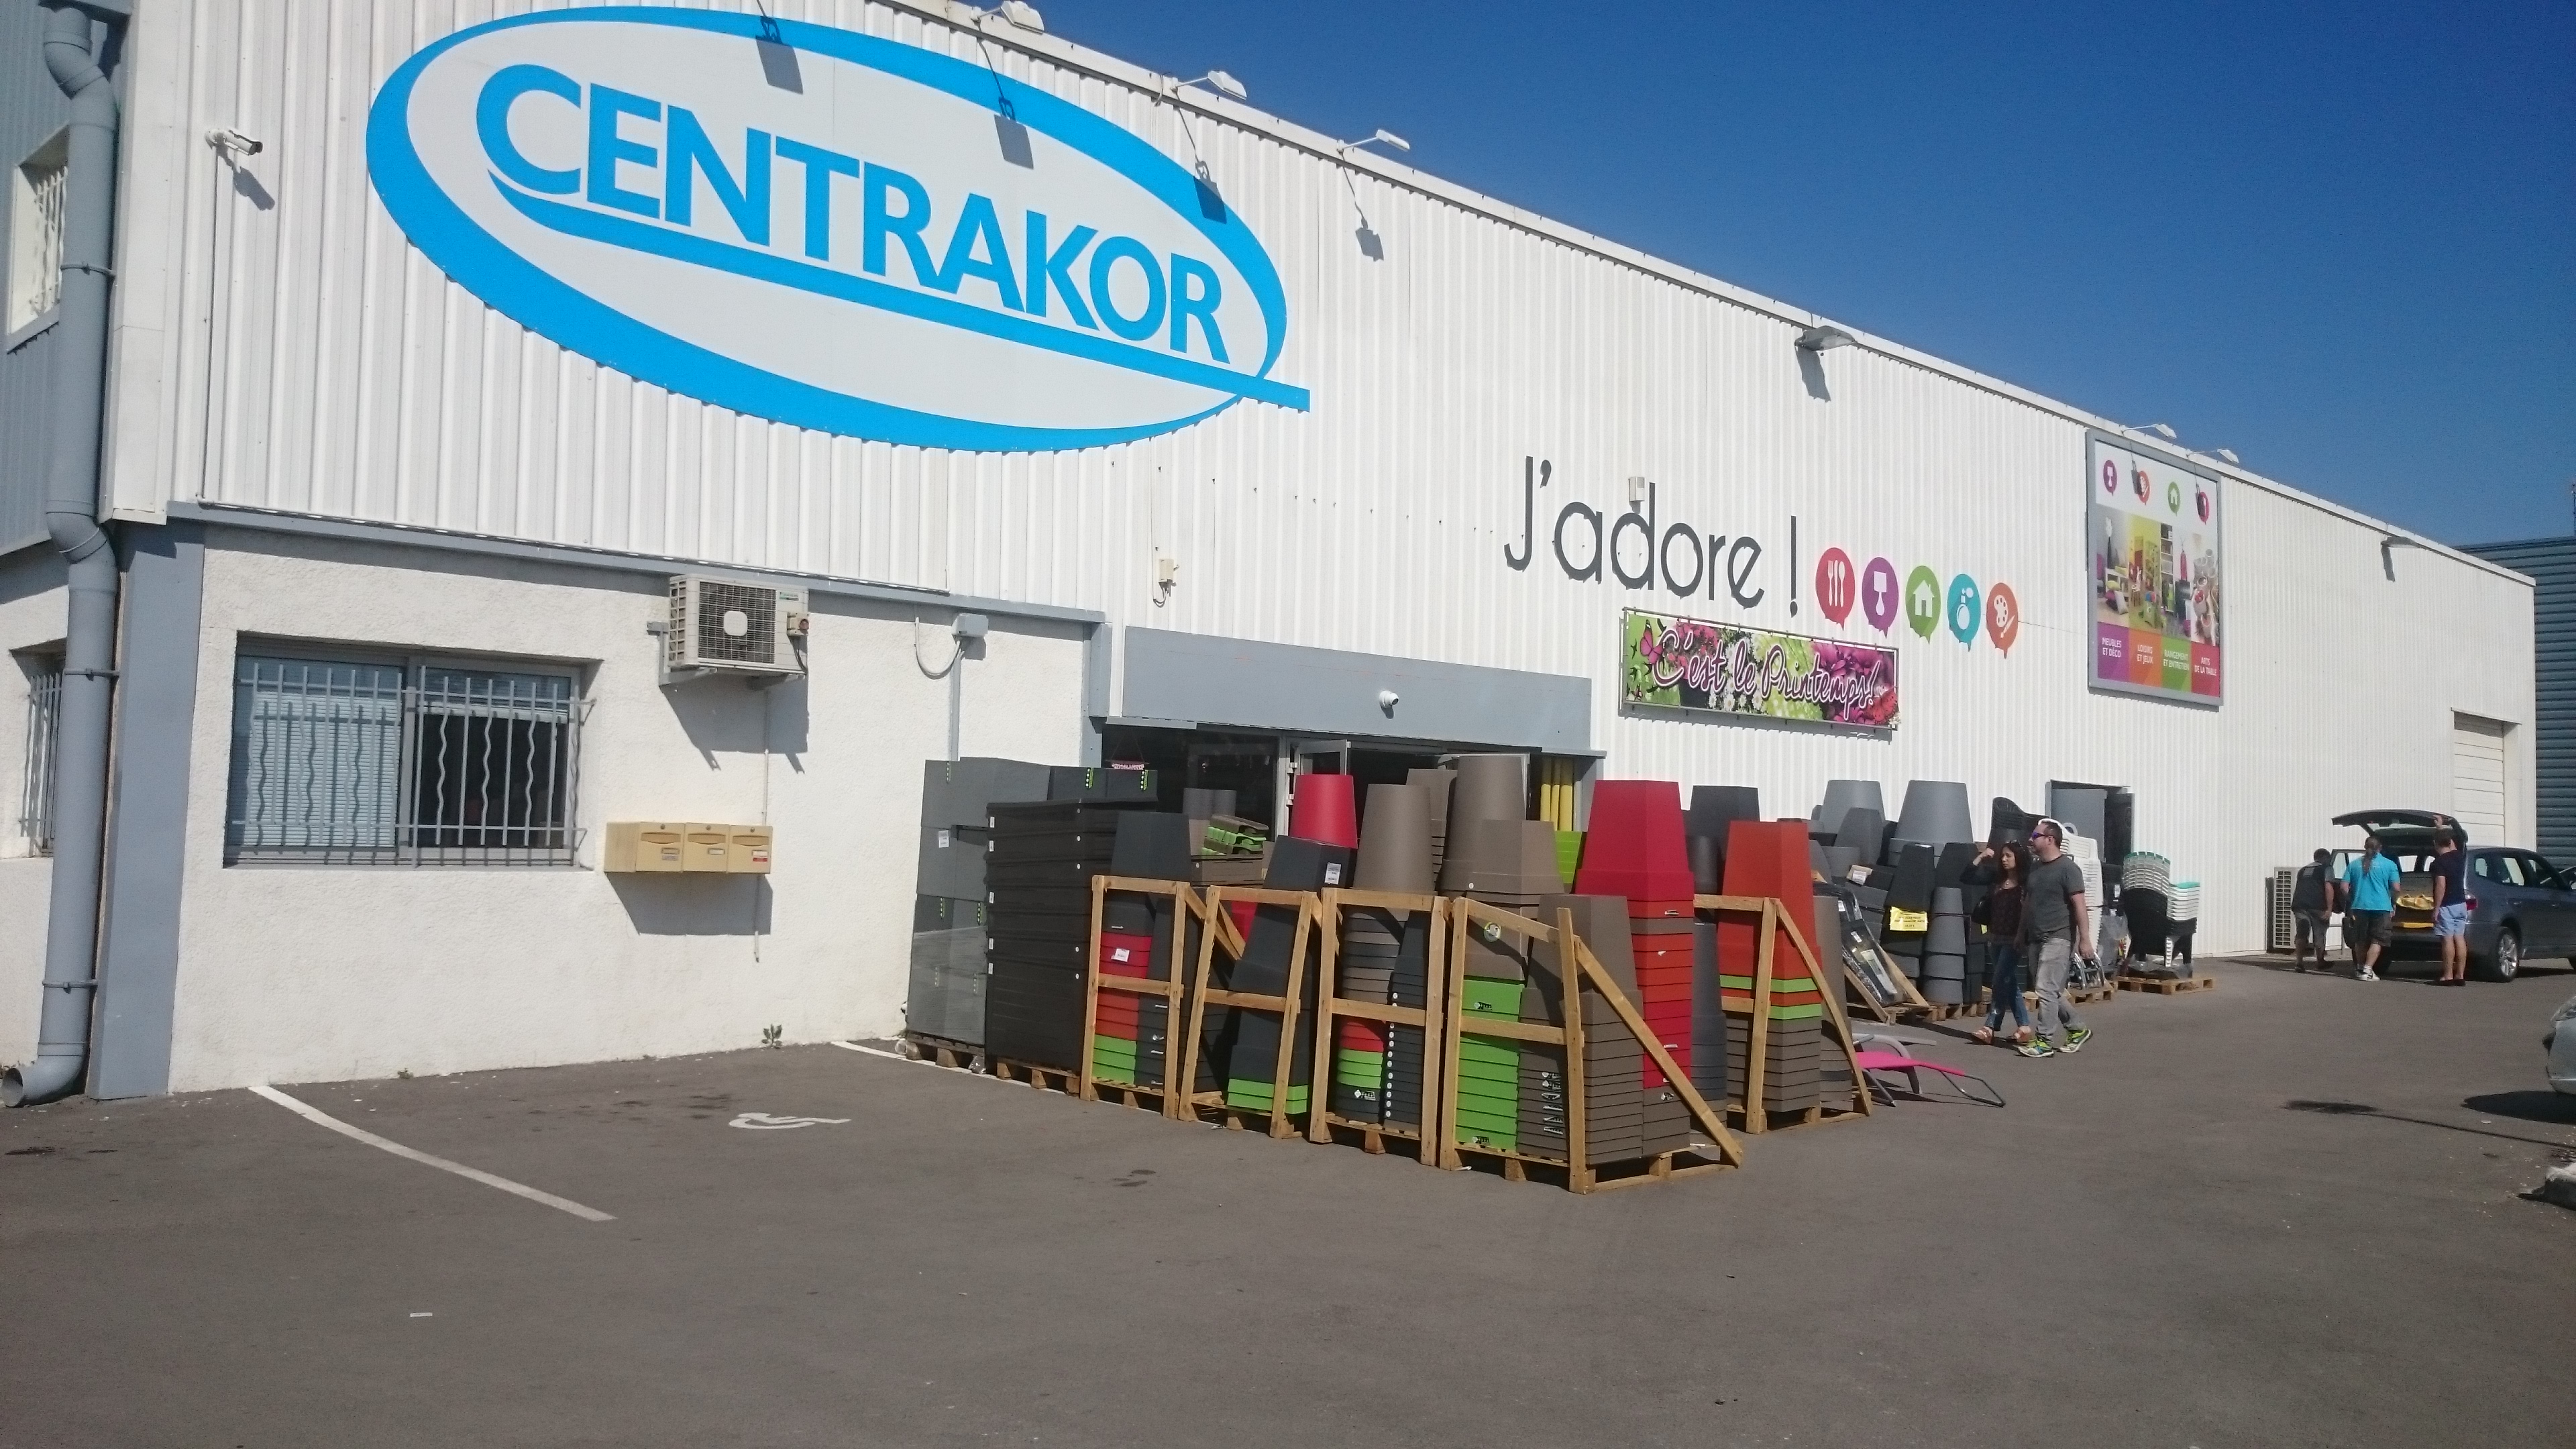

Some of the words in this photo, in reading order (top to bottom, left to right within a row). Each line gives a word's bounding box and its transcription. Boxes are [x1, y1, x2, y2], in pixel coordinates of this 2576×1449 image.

[476, 63, 1230, 364] CENTRAKOR
[1504, 455, 1765, 608] J'adore
[2102, 637, 2121, 648] MEUBLES
[2102, 647, 2108, 655] ET
[2108, 647, 2121, 657] DÉCO
[2137, 653, 2143, 661] ET
[1652, 628, 1727, 693] C'est
[1733, 639, 1757, 694] le
[1761, 643, 1882, 720] Printemps!
[2194, 665, 2200, 673] DE
